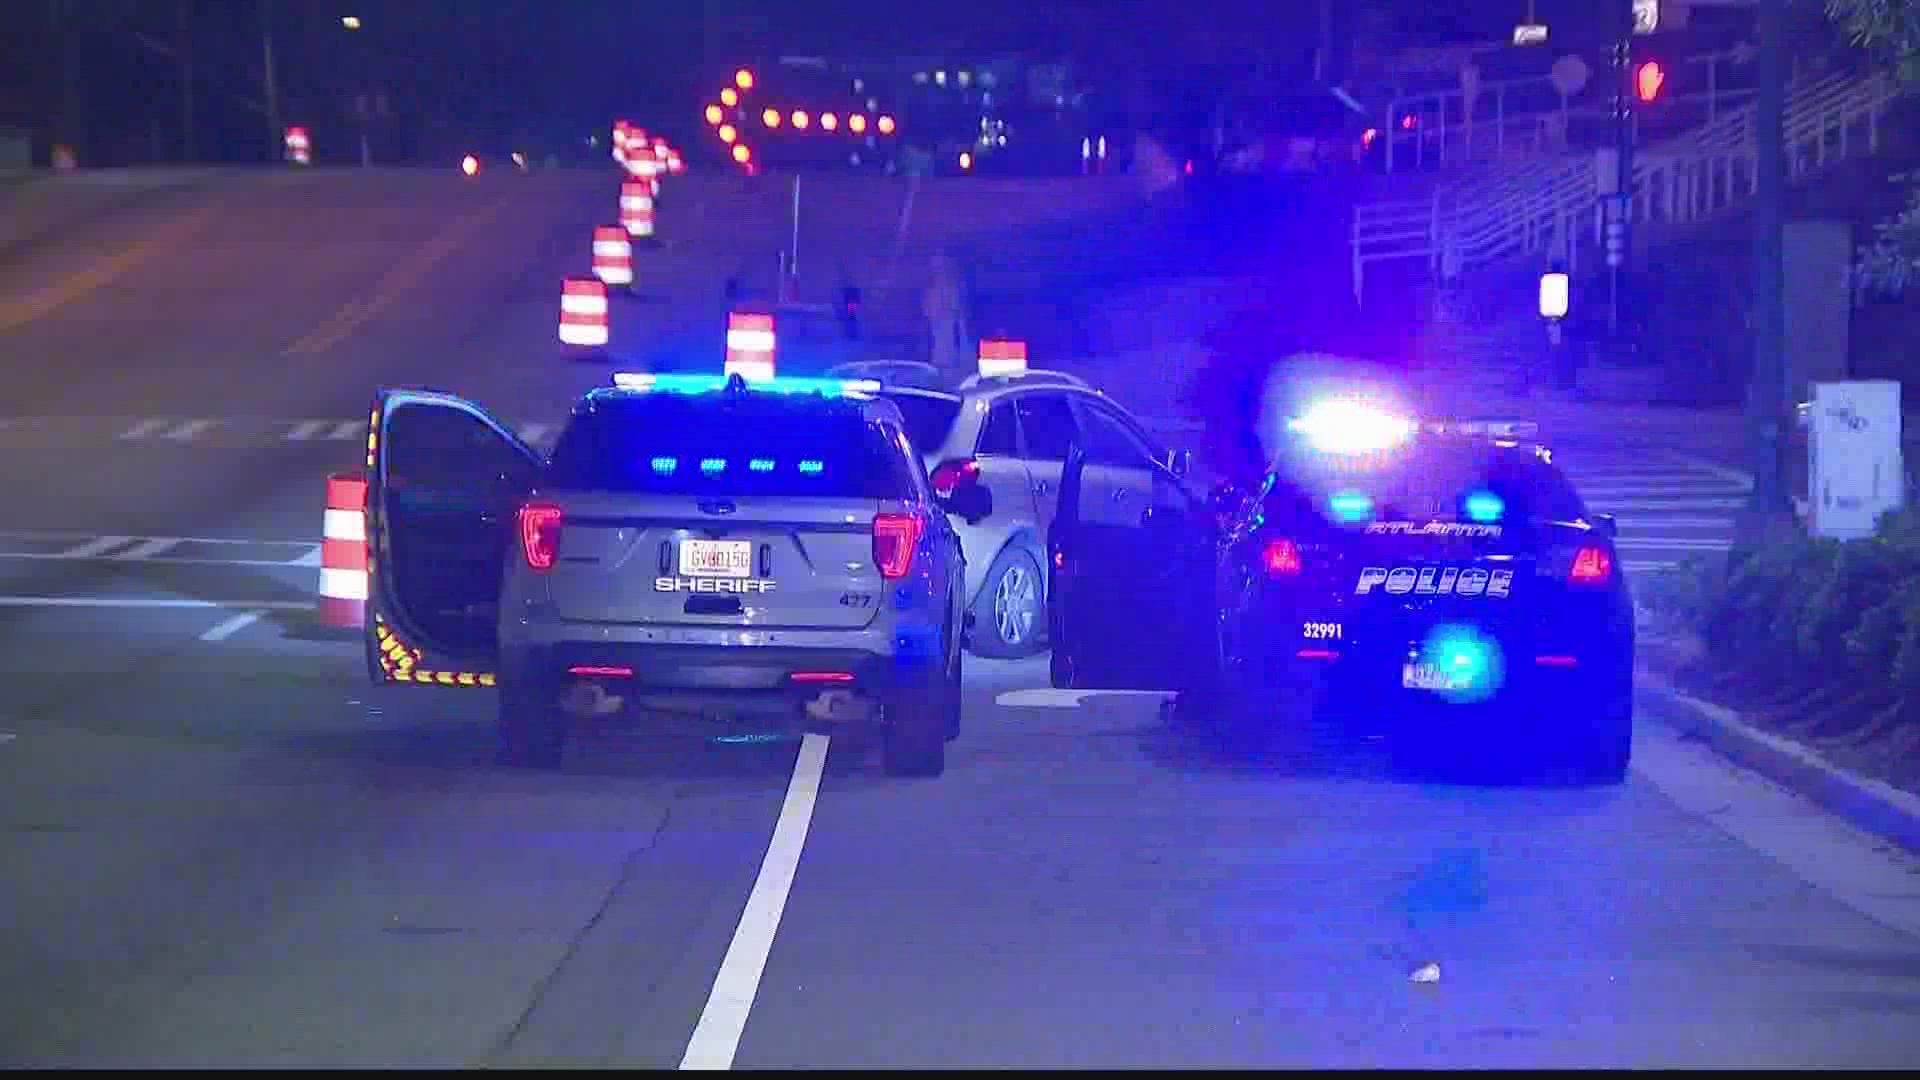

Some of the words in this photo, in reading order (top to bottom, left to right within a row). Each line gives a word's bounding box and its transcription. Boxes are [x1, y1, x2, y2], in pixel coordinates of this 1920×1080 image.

[655, 577, 776, 593] SHERIFF
[1355, 567, 1513, 598] POLICE
[1303, 621, 1343, 640] 32991
